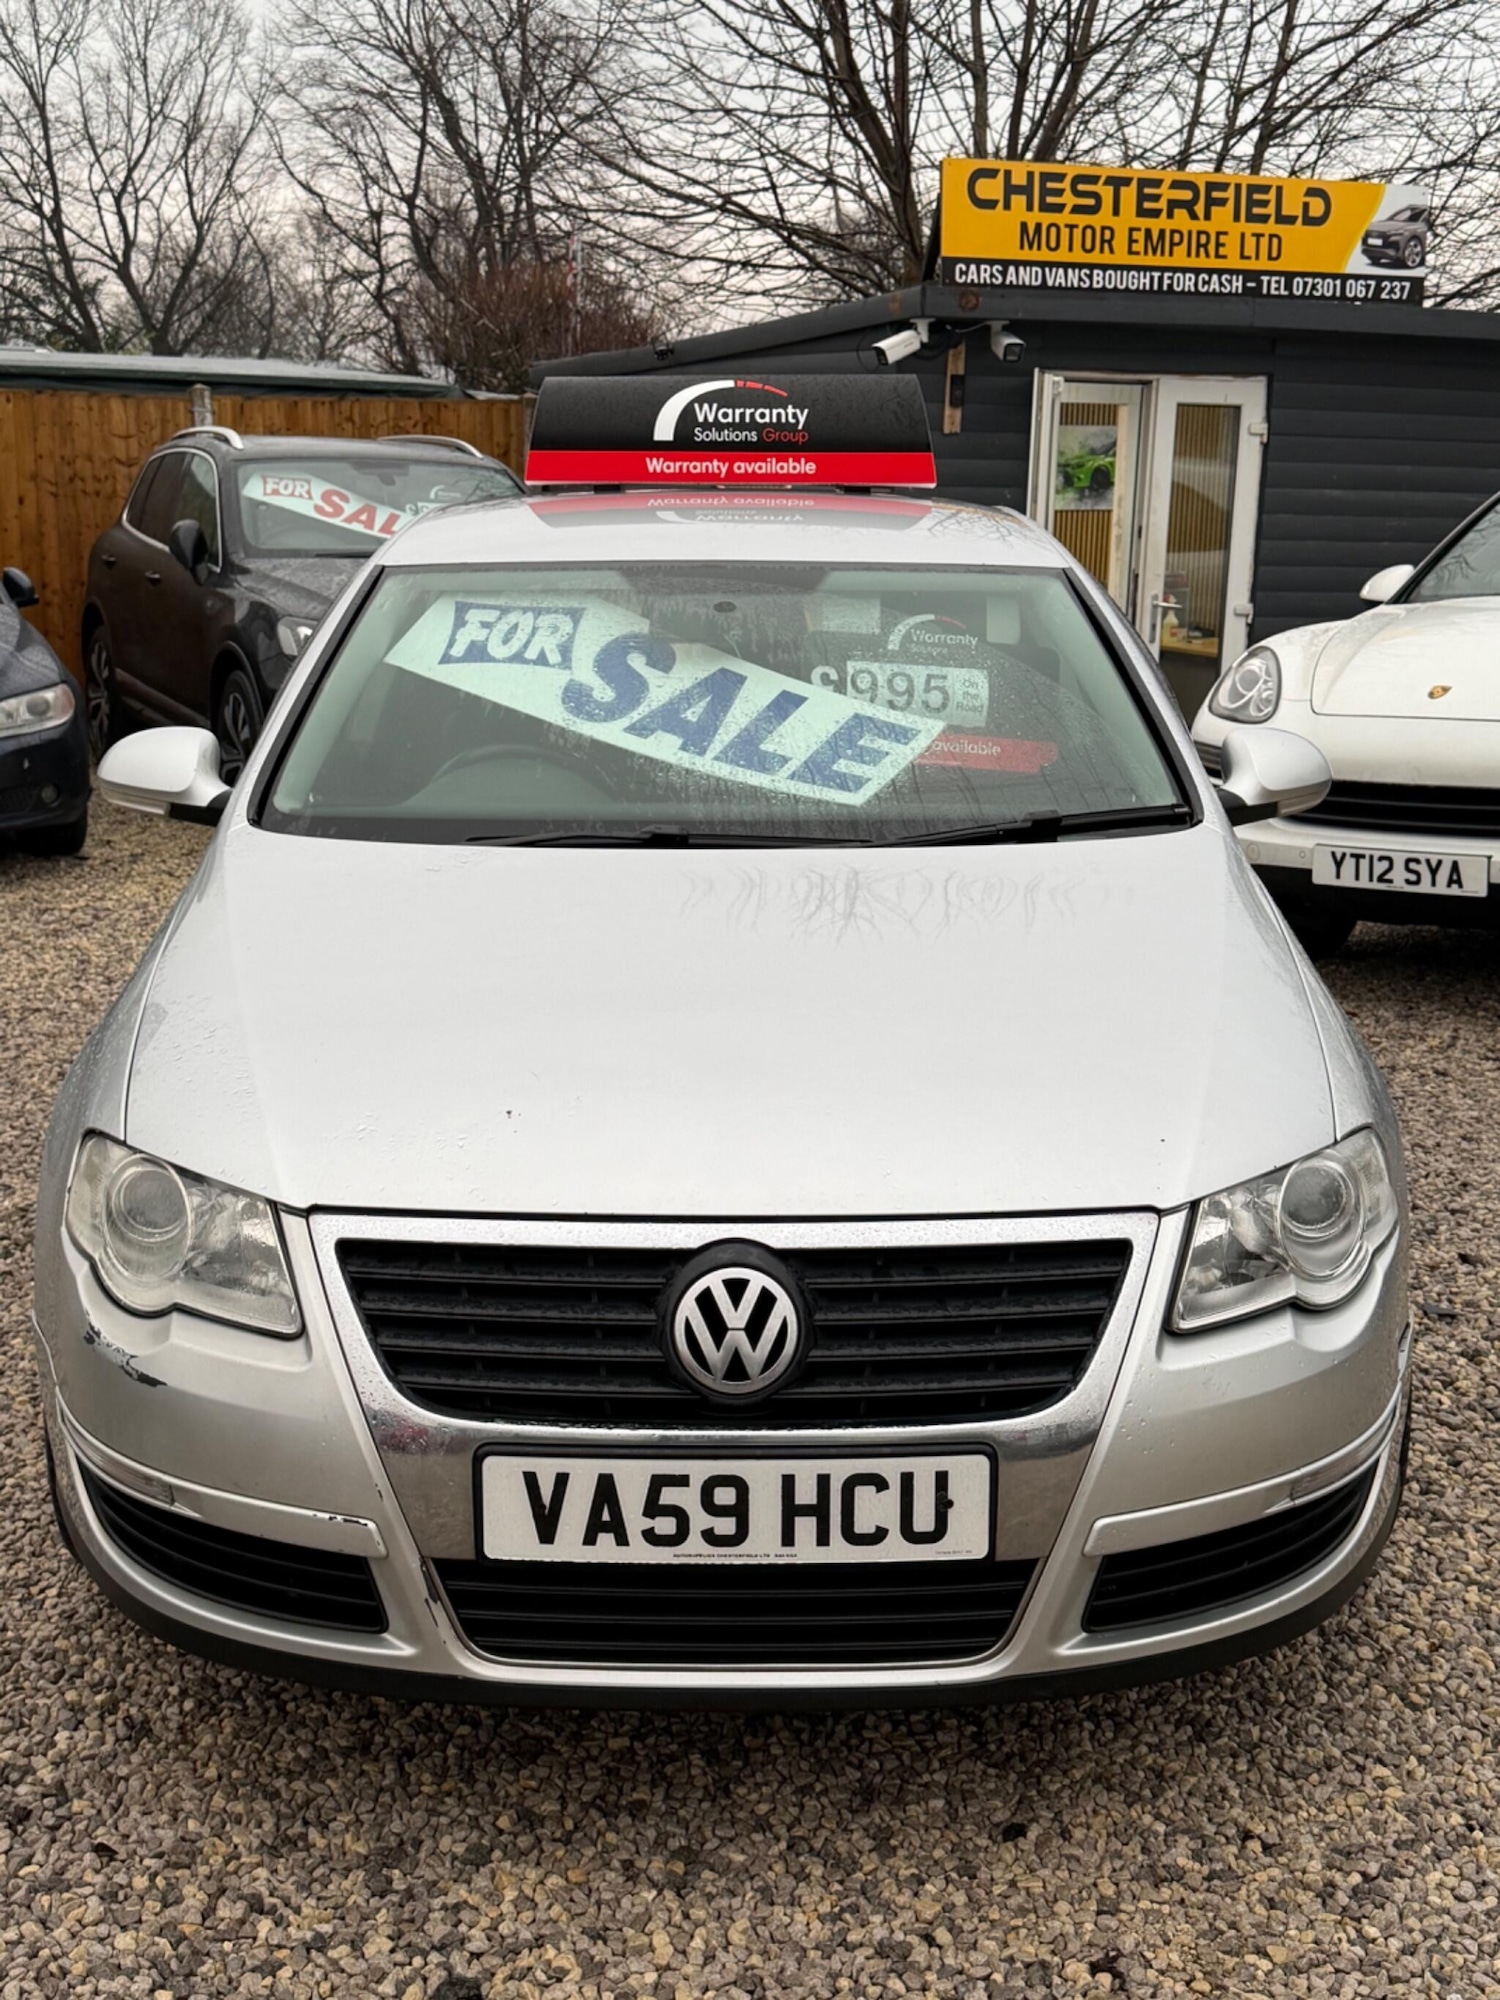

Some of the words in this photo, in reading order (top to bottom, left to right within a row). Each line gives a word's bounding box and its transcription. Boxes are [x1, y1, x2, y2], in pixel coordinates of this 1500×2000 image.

[967, 167, 1332, 227] CHESTERFIELD
[1019, 221, 1116, 255] MOTOR
[1127, 226, 1229, 260] EMPIRE
[1239, 231, 1283, 262] LTD
[955, 263, 1003, 285] CARS
[1005, 265, 1043, 287] AND
[1044, 267, 1091, 289] VANS
[1092, 269, 1162, 291] BOUGHT
[1163, 272, 1196, 293] FOR
[1197, 273, 1243, 294] CASH
[1260, 275, 1289, 295] TEL
[1292, 278, 1341, 297] 07301
[1346, 280, 1376, 299] 067
[1380, 281, 1411, 300] 237
[693, 402, 809, 430] Warranty
[693, 427, 758, 442] Solutions
[762, 427, 809, 445] Group
[645, 457, 729, 479] Warranty
[733, 457, 817, 474] available
[264, 476, 312, 499] FOR
[313, 488, 401, 536] SAL
[910, 628, 979, 650] Warranty
[962, 679, 979, 690] On
[962, 690, 980, 702] the
[449, 608, 574, 665] FOR
[560, 631, 923, 794] SALE
[955, 701, 984, 715] Road
[932, 739, 1002, 757] available
[1330, 850, 1395, 885] YT12
[1403, 857, 1464, 890] SYA
[680, 1272, 793, 1388] VW
[521, 1470, 750, 1548] VA59
[780, 1469, 951, 1548] HCU
